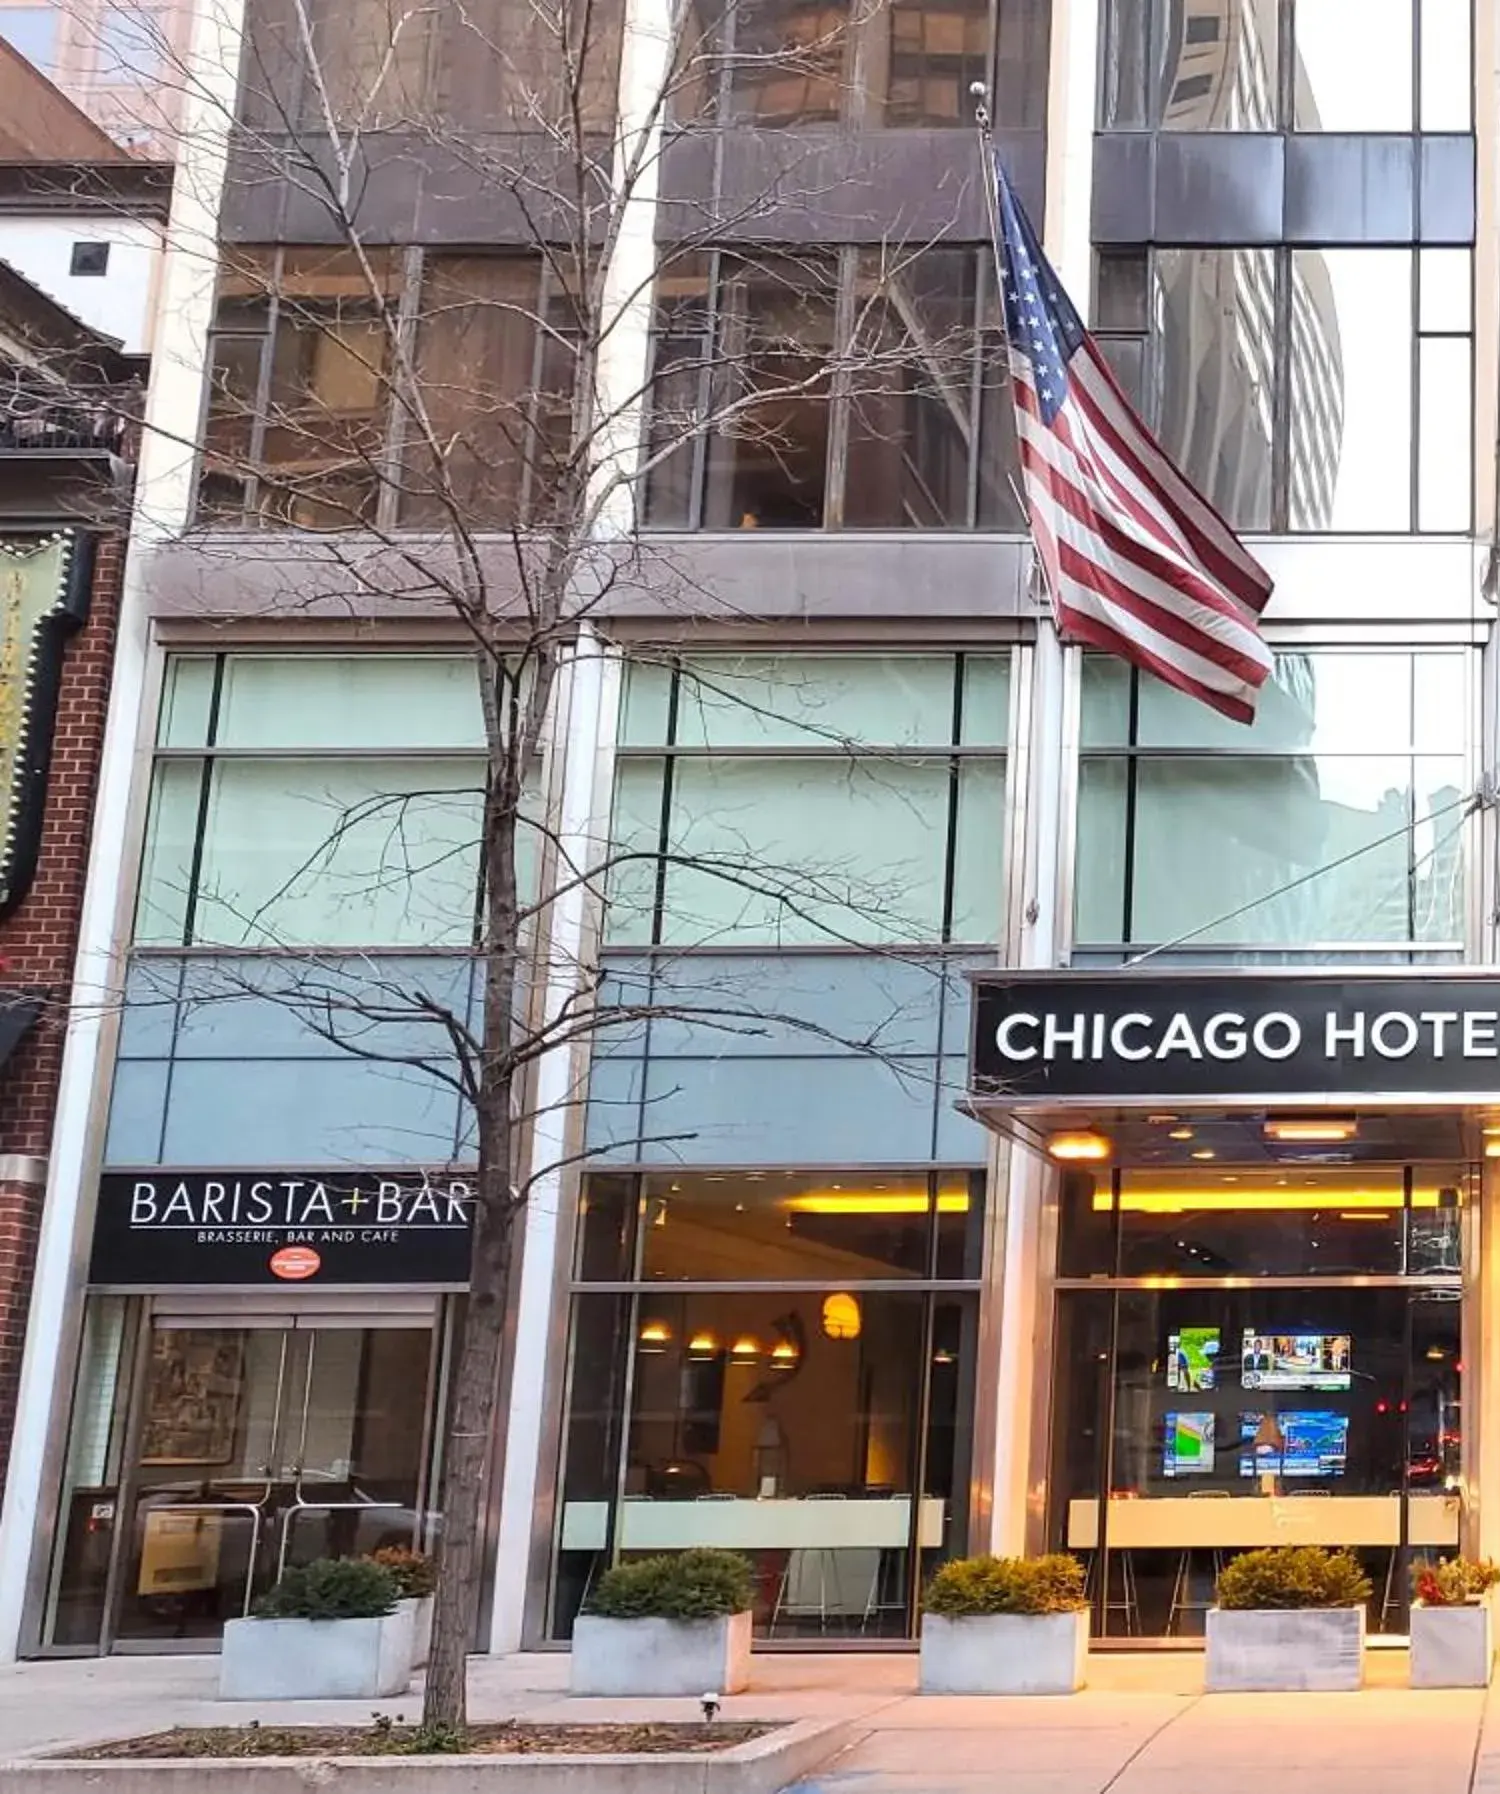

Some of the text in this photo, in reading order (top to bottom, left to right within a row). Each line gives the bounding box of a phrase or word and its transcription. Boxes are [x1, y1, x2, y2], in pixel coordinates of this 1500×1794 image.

[996, 1011, 1301, 1060] CHICAGO
[197, 1231, 280, 1244] BRASSERIE,
[287, 1231, 315, 1243] BAR
[321, 1231, 355, 1243] AND
